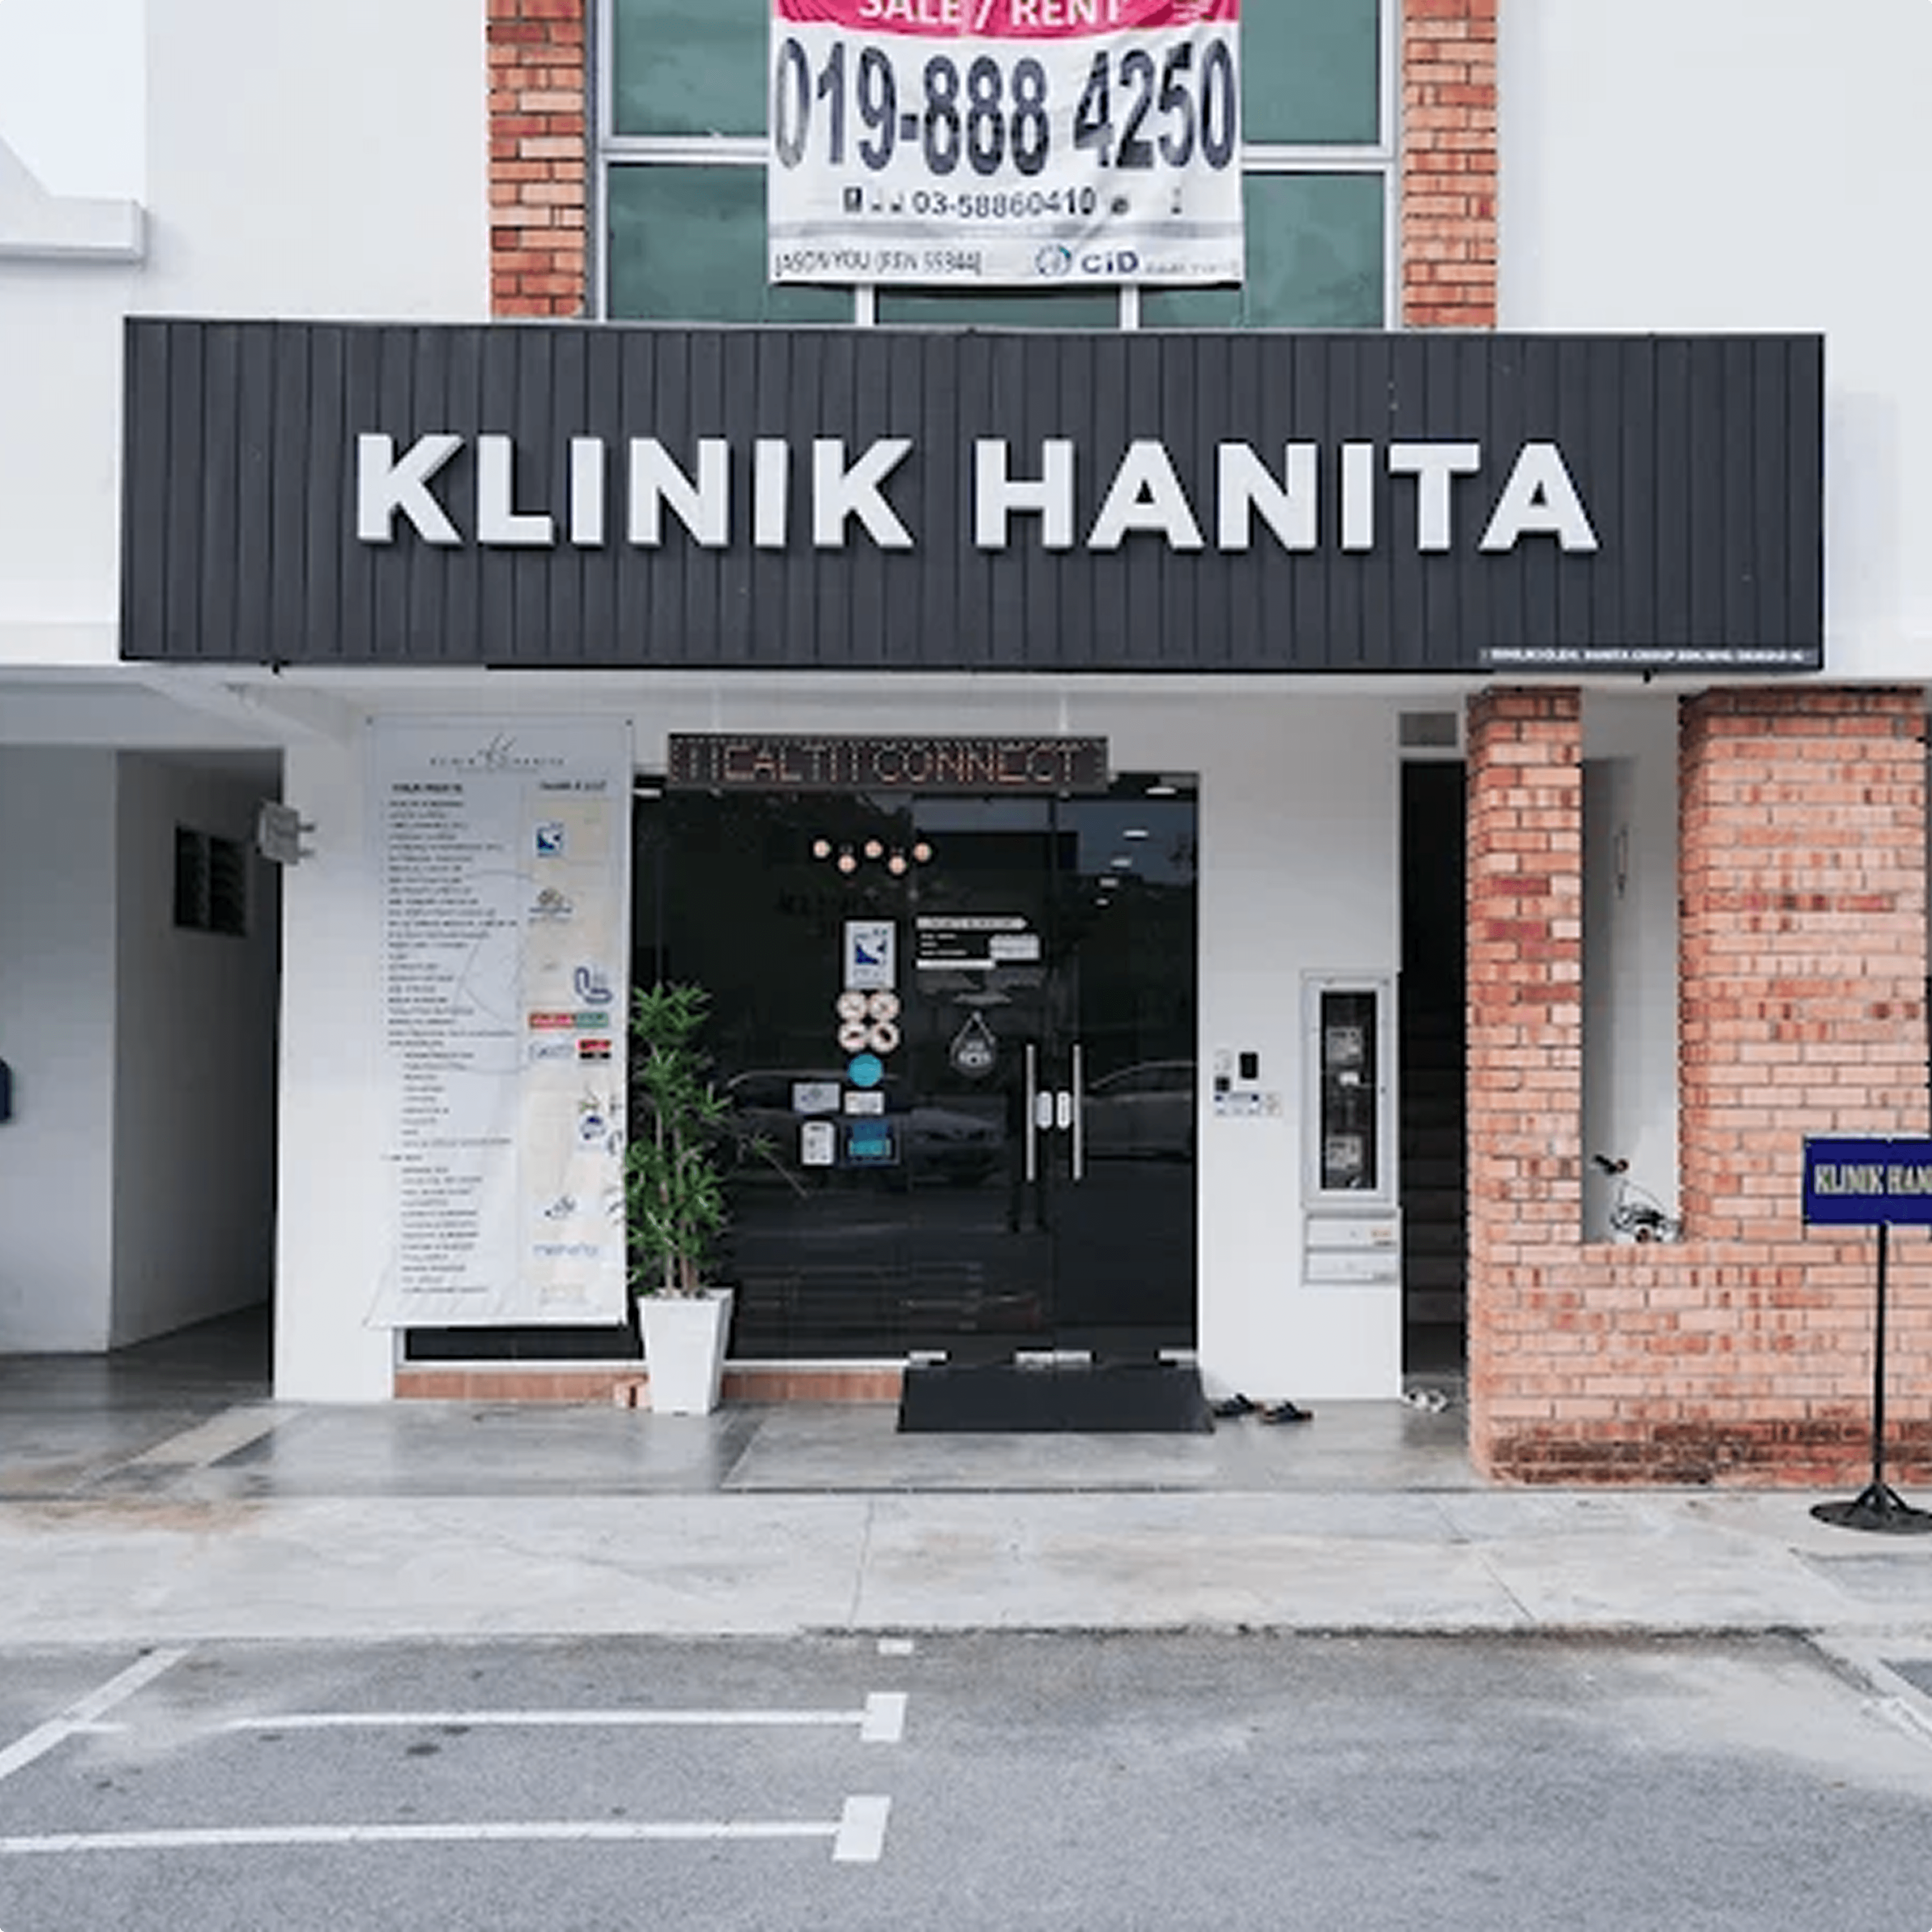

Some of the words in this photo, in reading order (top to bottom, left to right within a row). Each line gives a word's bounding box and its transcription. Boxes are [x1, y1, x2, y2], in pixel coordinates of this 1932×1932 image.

[775, 37, 1050, 176] 019-888
[1073, 38, 1236, 170] 4250
[356, 433, 915, 549] KLINIK
[974, 438, 1600, 553] HANITA
[872, 742, 1084, 785] CONNECT
[1814, 1164, 1884, 1195] KLINIK
